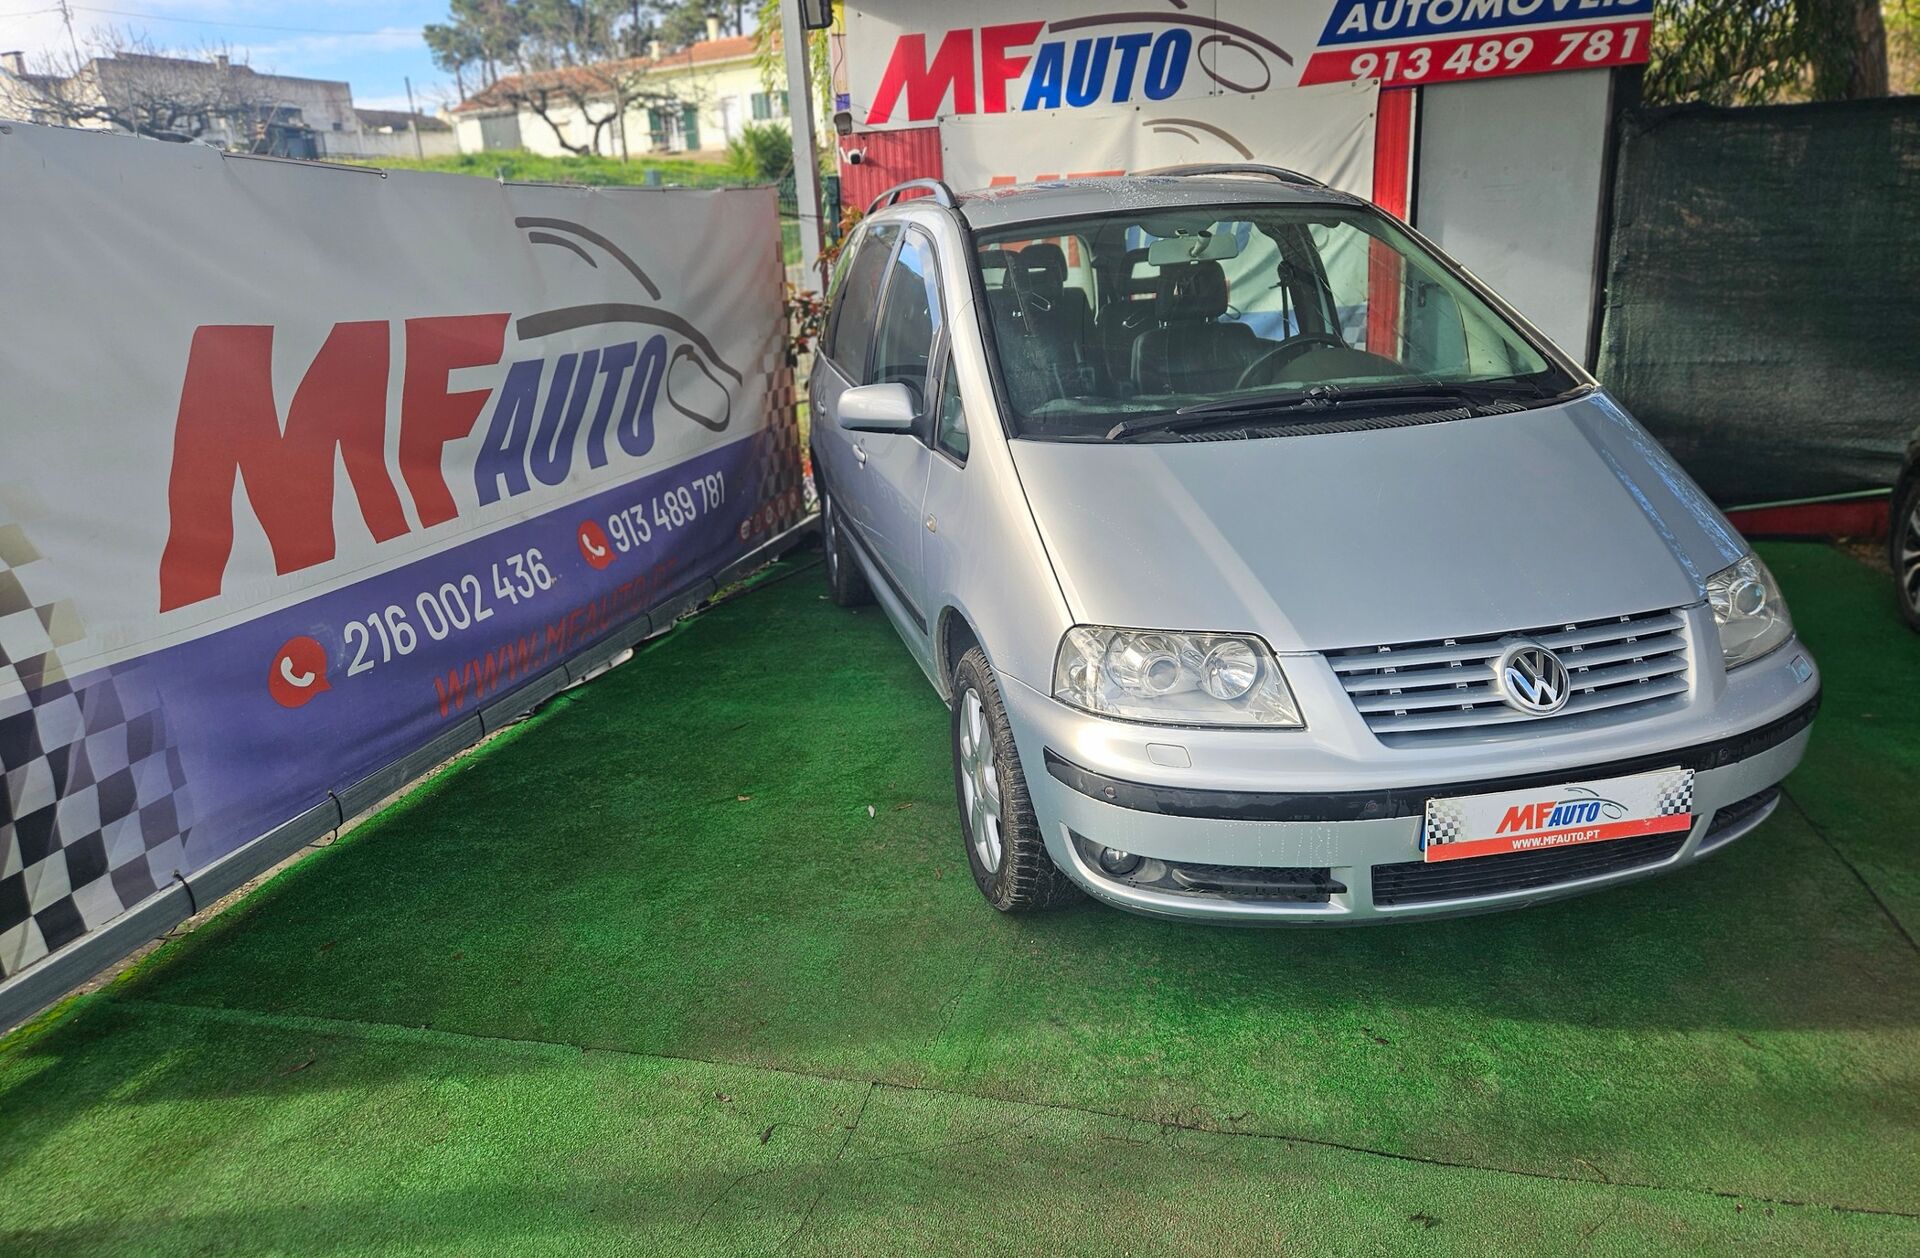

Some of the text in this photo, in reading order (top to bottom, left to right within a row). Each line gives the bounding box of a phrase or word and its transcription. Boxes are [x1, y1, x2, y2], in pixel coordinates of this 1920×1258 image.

[1336, 0, 1639, 35] AUTOM
[1350, 27, 1640, 82] 913 489 781
[608, 470, 726, 553] 913 489 781
[343, 547, 552, 677] 216 002 436
[1511, 829, 1601, 850] WWW.MFAUTO.PT
